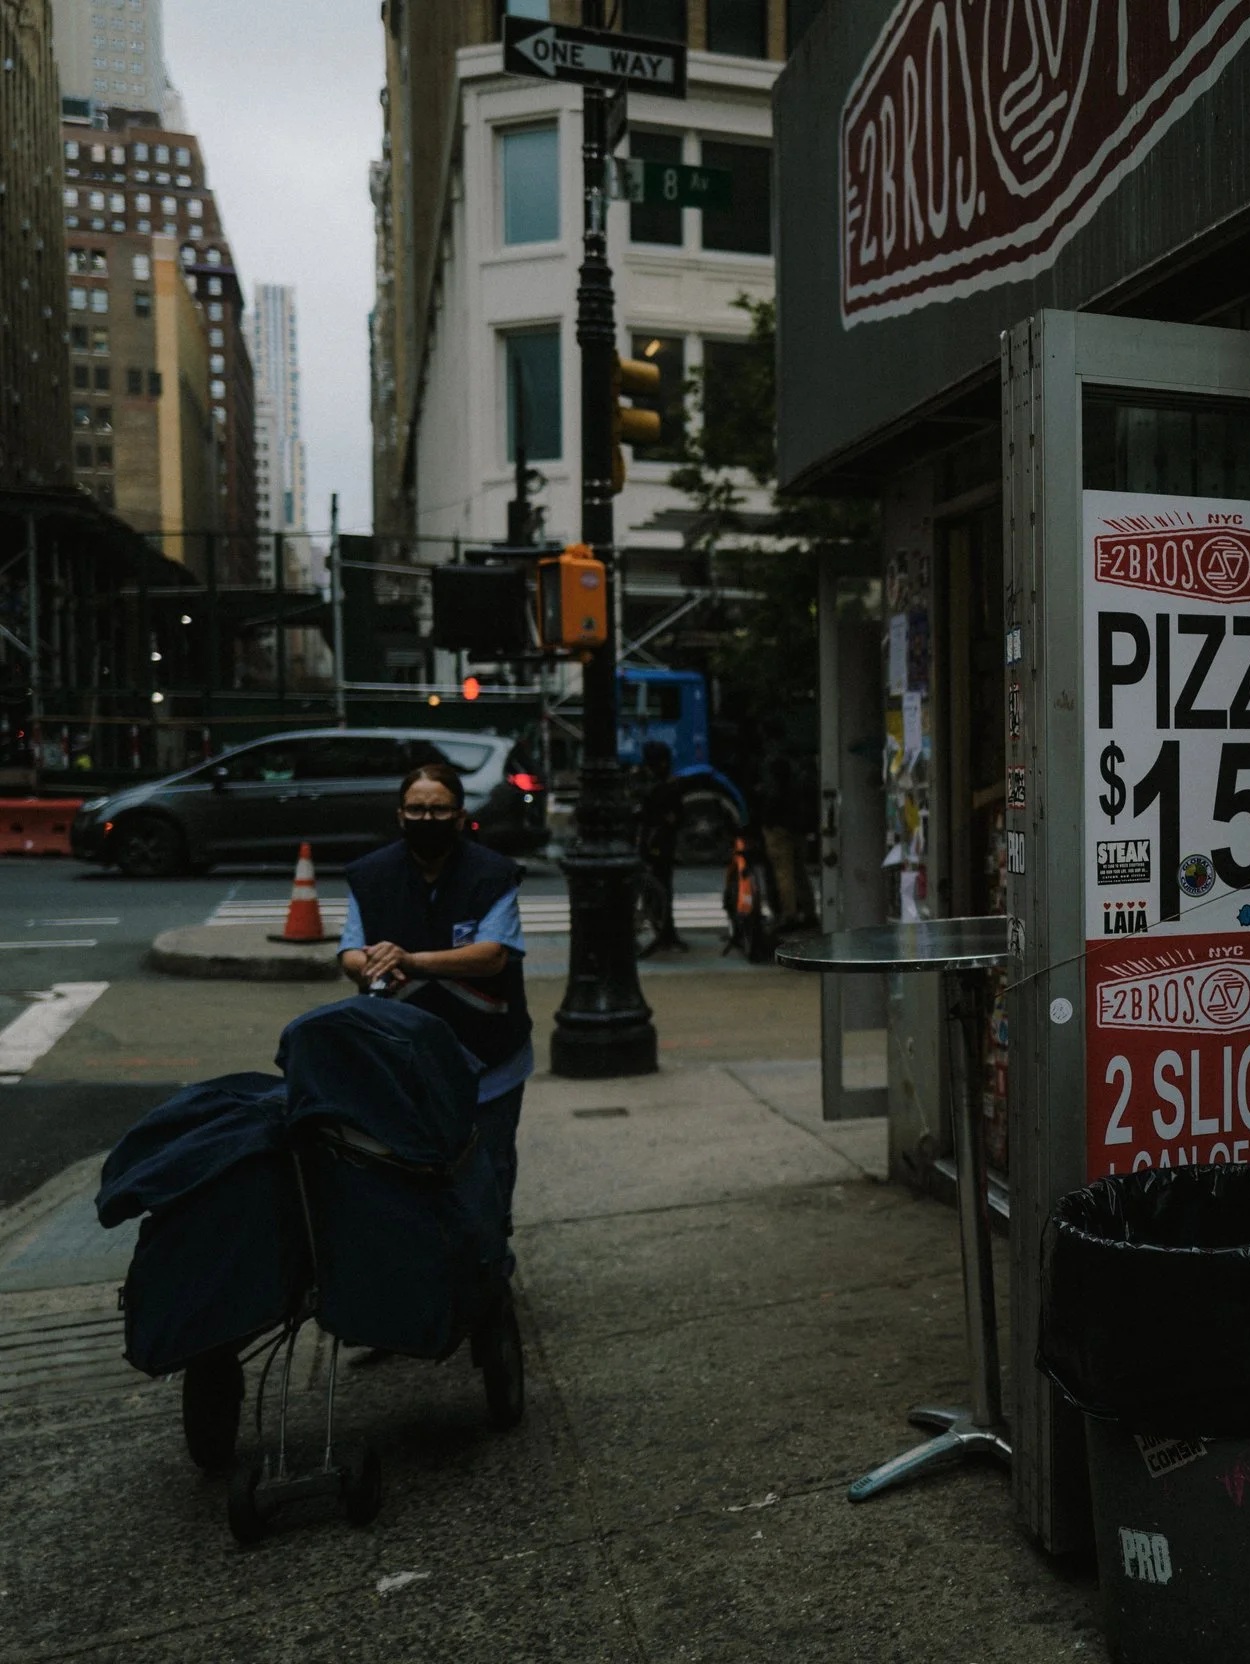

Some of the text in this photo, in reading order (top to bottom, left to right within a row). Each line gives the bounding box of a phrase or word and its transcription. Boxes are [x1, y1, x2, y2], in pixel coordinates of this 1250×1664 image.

[533, 38, 663, 77] ONE WAY
[662, 168, 679, 200] 8
[1208, 513, 1243, 525] NYC
[1097, 841, 1149, 864] STEAK
[1104, 910, 1148, 935] LAIA
[1208, 945, 1244, 958] NYC
[1104, 1054, 1133, 1146] 2
[1120, 1528, 1173, 1585] PRO
